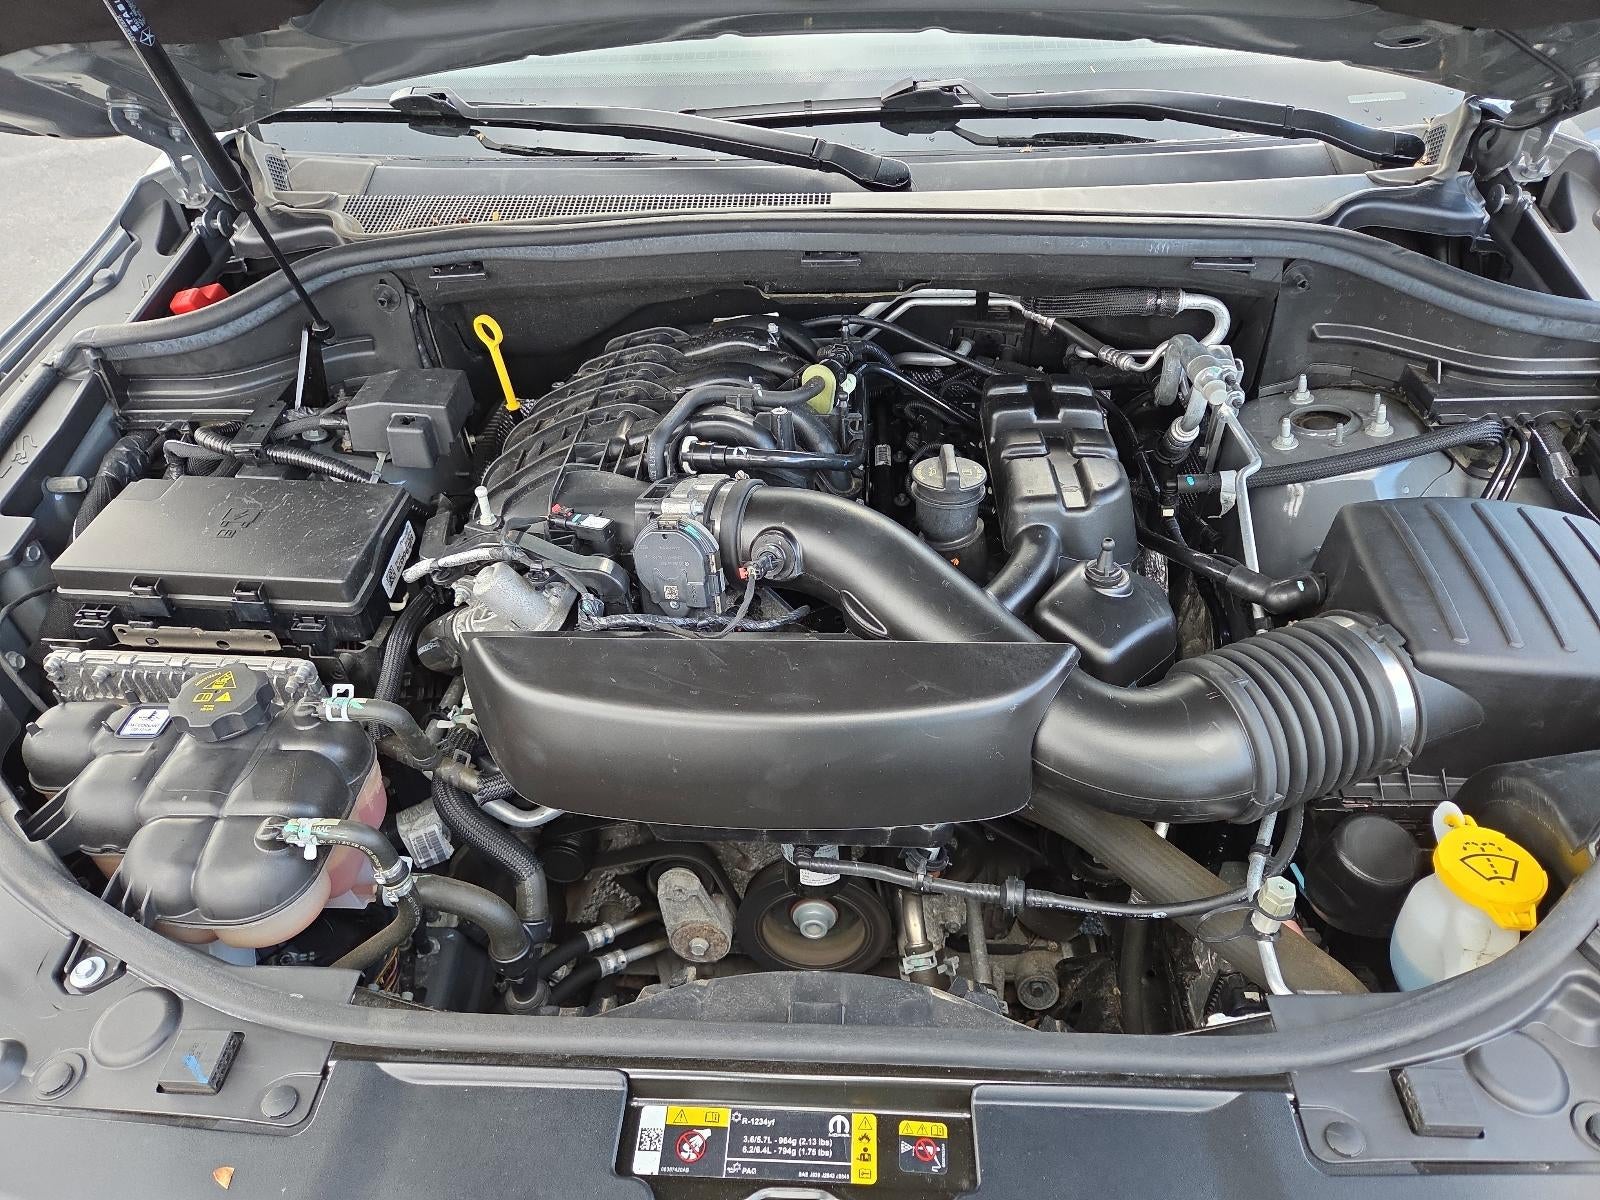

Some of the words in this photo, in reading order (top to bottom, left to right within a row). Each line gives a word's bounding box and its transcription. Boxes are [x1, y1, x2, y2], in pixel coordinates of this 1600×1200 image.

[741, 1117, 775, 1128] R-1234yf
[798, 1137, 817, 1147] (2.13
[818, 1138, 833, 1148] lbs)
[778, 1147, 797, 1157] 794g
[798, 1148, 817, 1157] (1.75
[818, 1149, 833, 1158] lbs)
[741, 1167, 757, 1175] PAG
